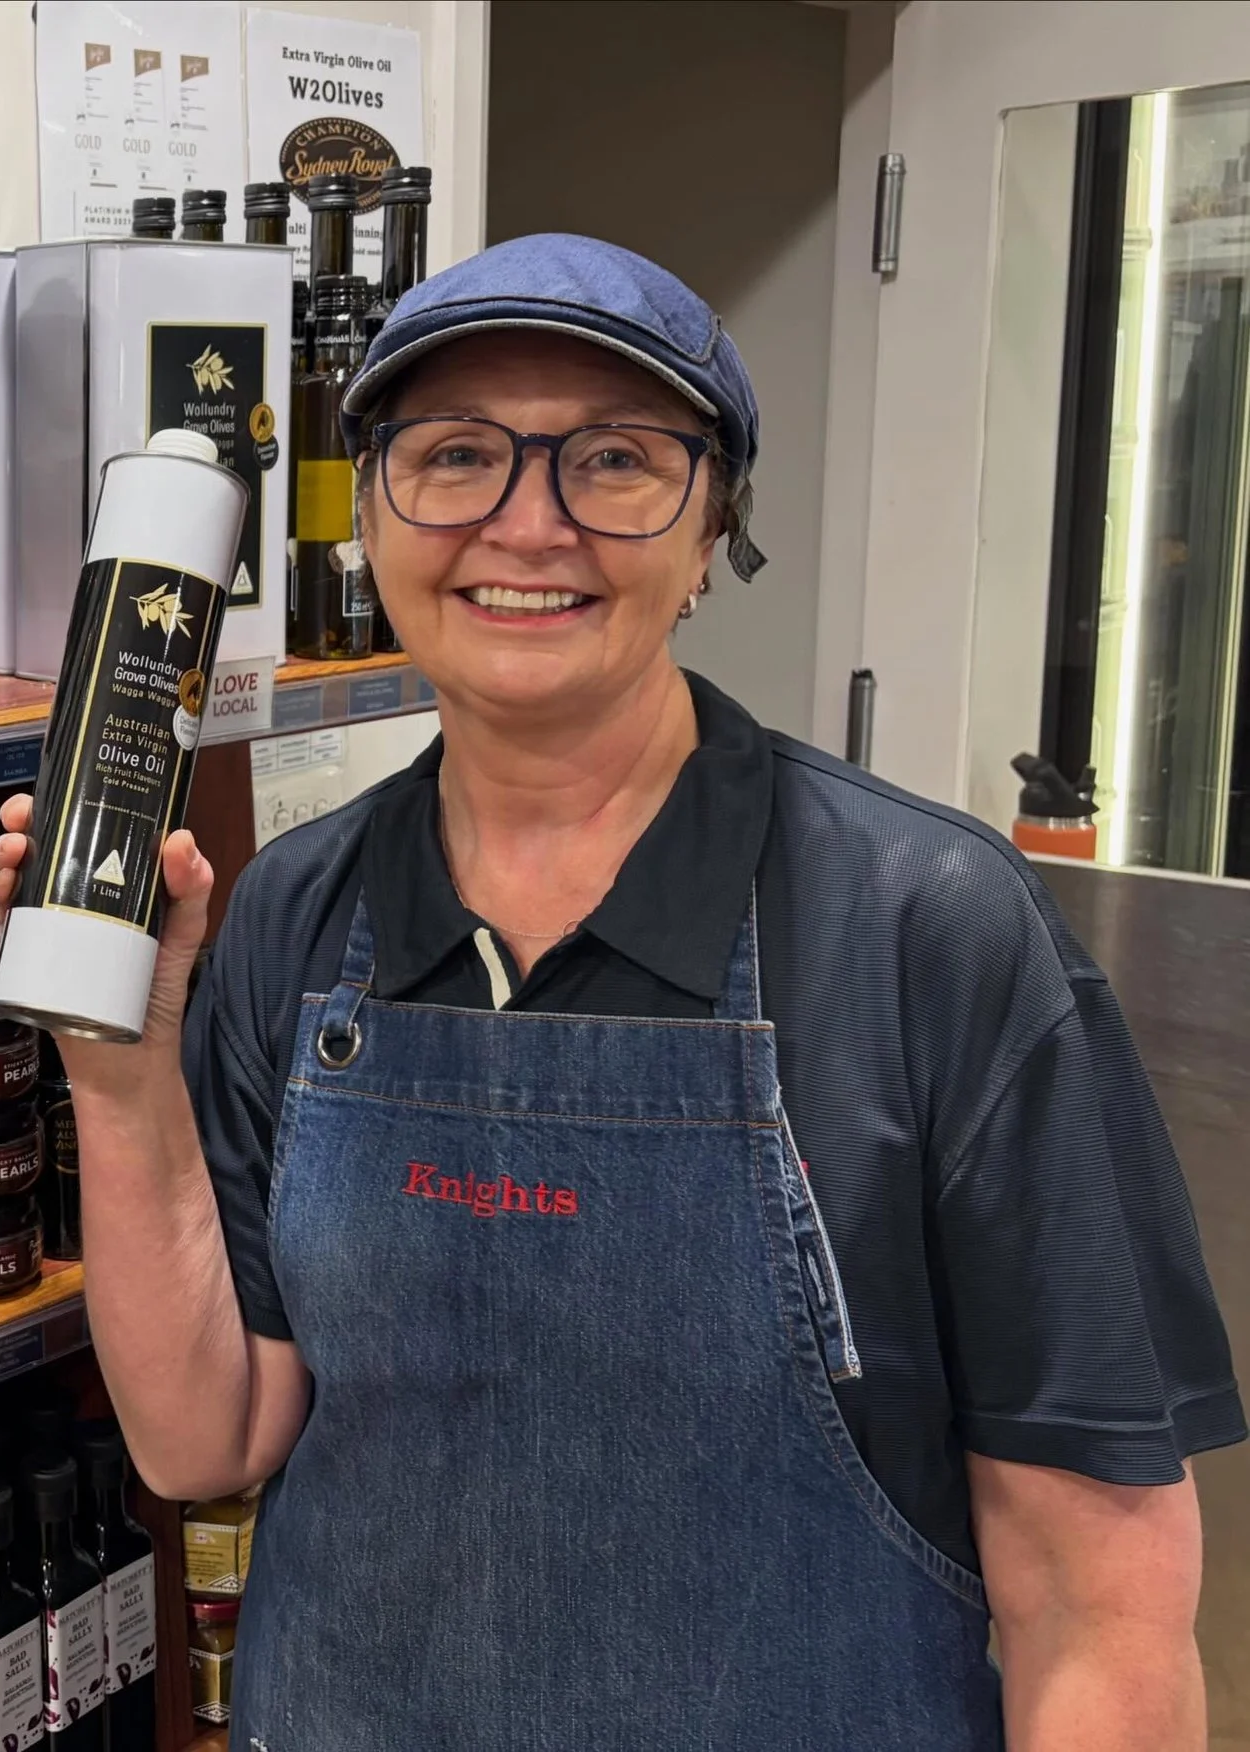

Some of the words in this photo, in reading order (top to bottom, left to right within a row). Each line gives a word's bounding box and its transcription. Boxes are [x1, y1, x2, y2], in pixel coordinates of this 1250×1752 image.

[282, 47, 311, 62] Extra
[313, 50, 344, 68] Virgin
[348, 55, 375, 70] Olive
[377, 59, 392, 73] Oil
[288, 76, 384, 109] W2Olives
[74, 134, 102, 150] GOLD
[123, 138, 151, 154] GOLD
[168, 141, 197, 157] GOLD
[296, 124, 382, 151] CHAMPION
[286, 149, 348, 186] Sydney
[348, 146, 395, 178] Royal
[183, 402, 236, 418] Wollundry
[210, 420, 235, 434] Olives
[118, 651, 183, 679] Wollundry
[114, 667, 147, 686] Grove
[149, 673, 180, 695] Olives
[214, 672, 259, 697] LOVE
[112, 683, 145, 698] Wagga
[148, 691, 177, 708] Wagga
[213, 698, 258, 717] LOCAL
[105, 713, 171, 741] Australian
[102, 728, 132, 745] Extra
[134, 735, 169, 755] Virgin
[95, 763, 112, 775] Rich
[114, 766, 132, 779] Fruit
[98, 744, 140, 768] Olive
[145, 754, 166, 776] Oil
[102, 776, 119, 787] Cold
[99, 886, 122, 900] Litre
[403, 1161, 579, 1217] Knights
[5, 1658, 32, 1681] SALLY
[9, 1650, 28, 1667] BAD
